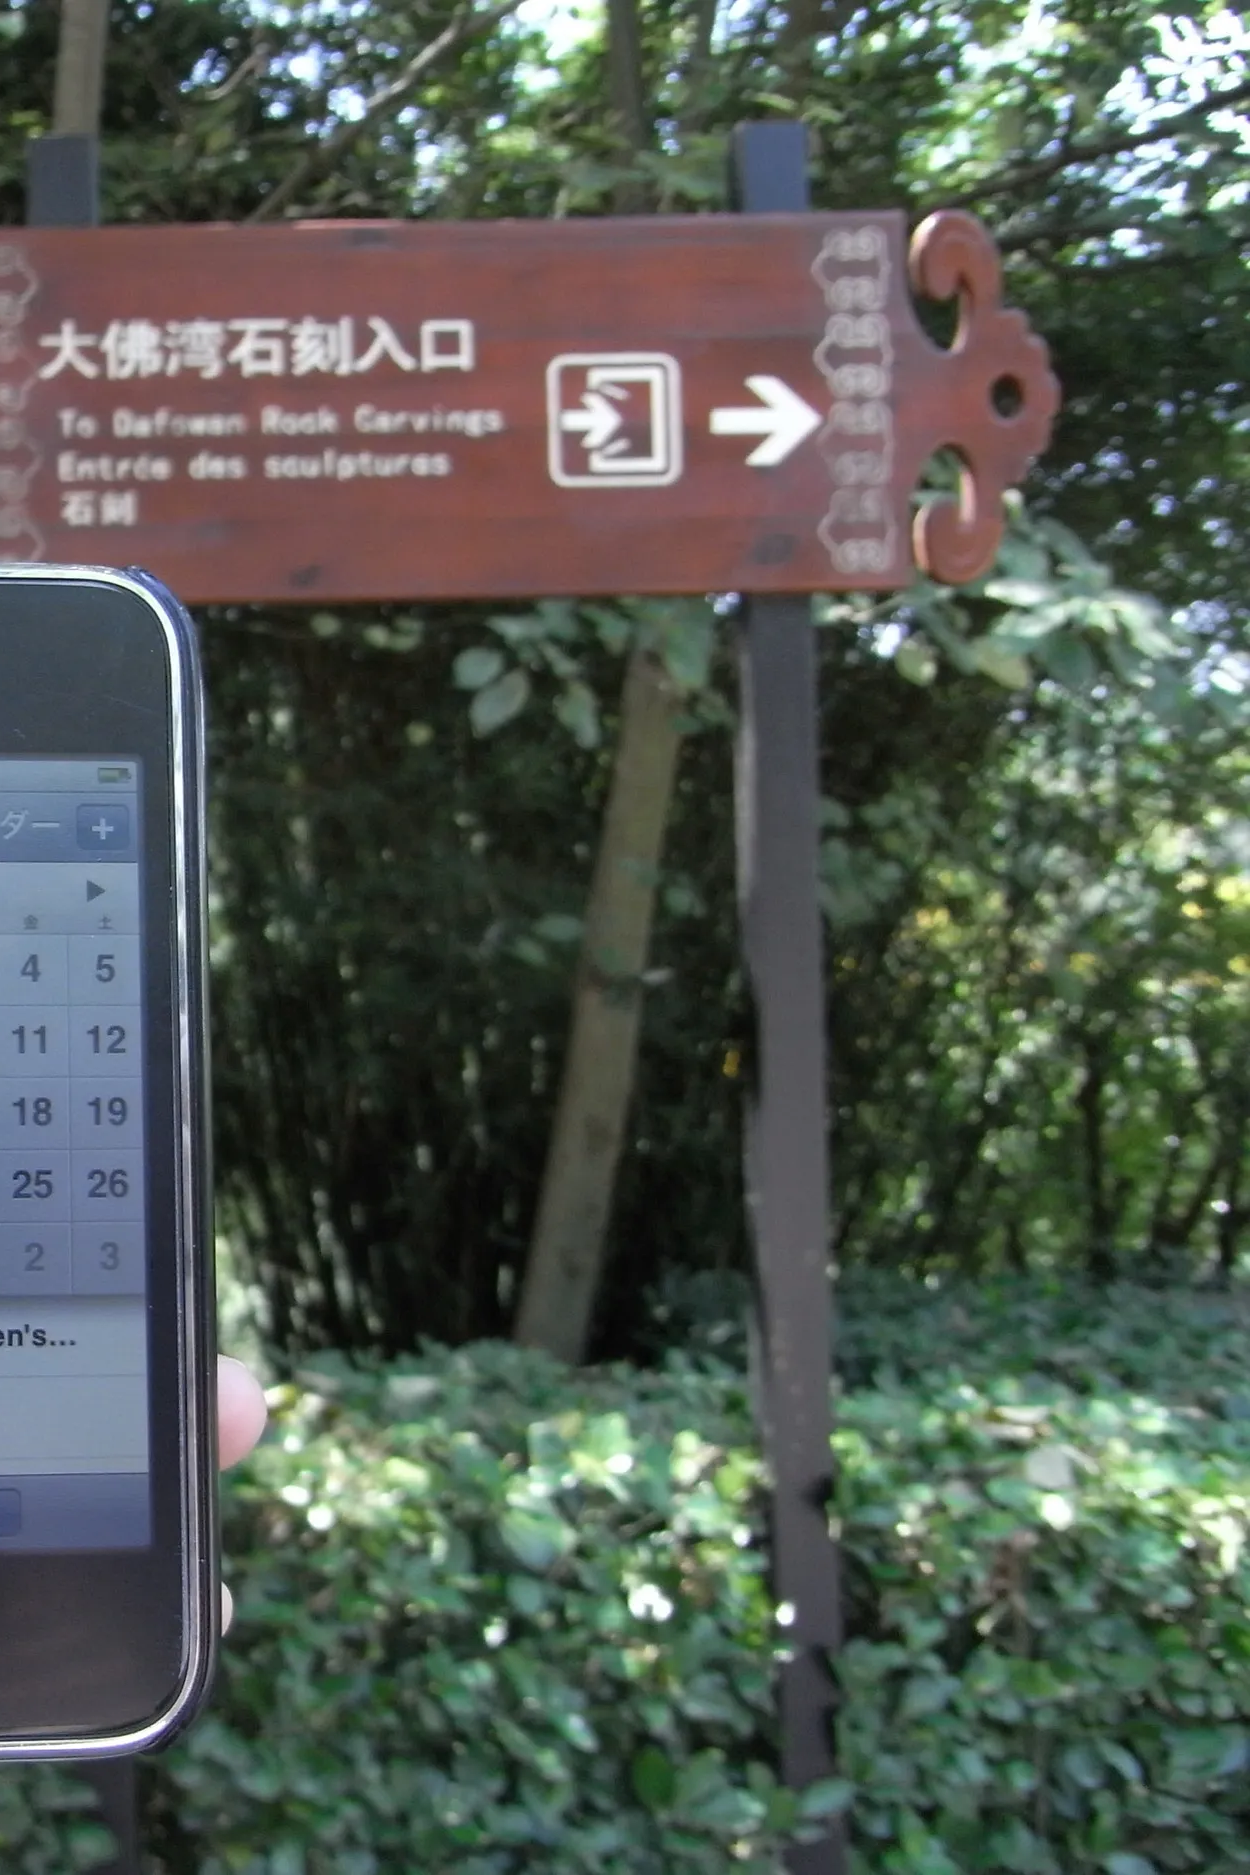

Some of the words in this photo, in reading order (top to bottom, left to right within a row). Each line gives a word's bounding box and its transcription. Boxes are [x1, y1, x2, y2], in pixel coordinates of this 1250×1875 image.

[40, 316, 475, 379] 大佛湾石刻入口
[58, 408, 97, 439] To
[261, 405, 338, 435] Rock
[354, 404, 504, 437] Carvings
[188, 450, 246, 481] des
[263, 448, 451, 481] sculptures
[23, 914, 39, 931] 金
[98, 914, 113, 931] 土
[20, 953, 42, 983] 4
[95, 954, 116, 984] 5
[11, 1025, 47, 1054] 11
[86, 1024, 127, 1054] 12
[12, 1097, 52, 1127] 18
[87, 1096, 128, 1126] 19
[12, 1169, 53, 1199] 25
[87, 1168, 129, 1198] 26
[24, 1242, 45, 1272] 2
[99, 1241, 120, 1271] 3
